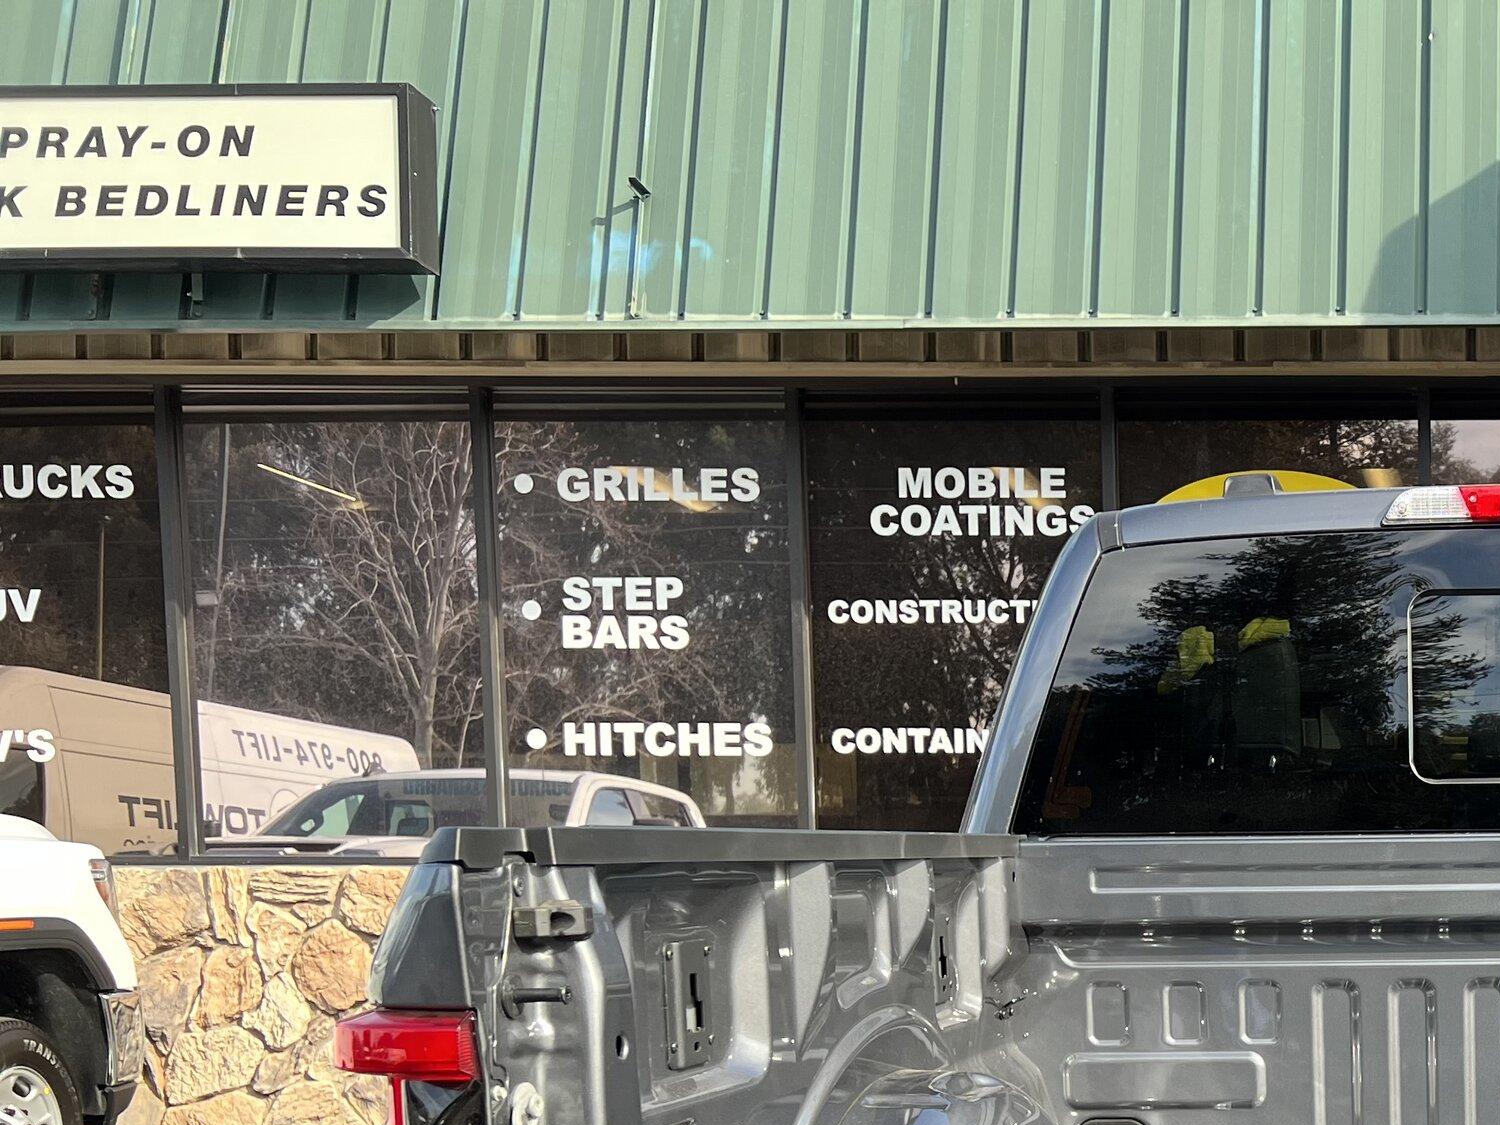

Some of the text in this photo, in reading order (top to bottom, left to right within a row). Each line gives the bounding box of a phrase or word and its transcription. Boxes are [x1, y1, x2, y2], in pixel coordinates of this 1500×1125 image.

[0, 125, 255, 158] PRAY-ON
[54, 184, 388, 218] BEDLINERS
[0, 464, 135, 499] UCKS
[556, 467, 761, 503] GRILLES
[897, 466, 1067, 499] MOBILE
[869, 504, 1095, 537] COATINGS
[0, 588, 42, 623] V
[562, 576, 684, 611] STEP
[561, 615, 690, 650] BARS
[562, 722, 774, 758] HITCHES
[831, 727, 990, 754] CONTAIN
